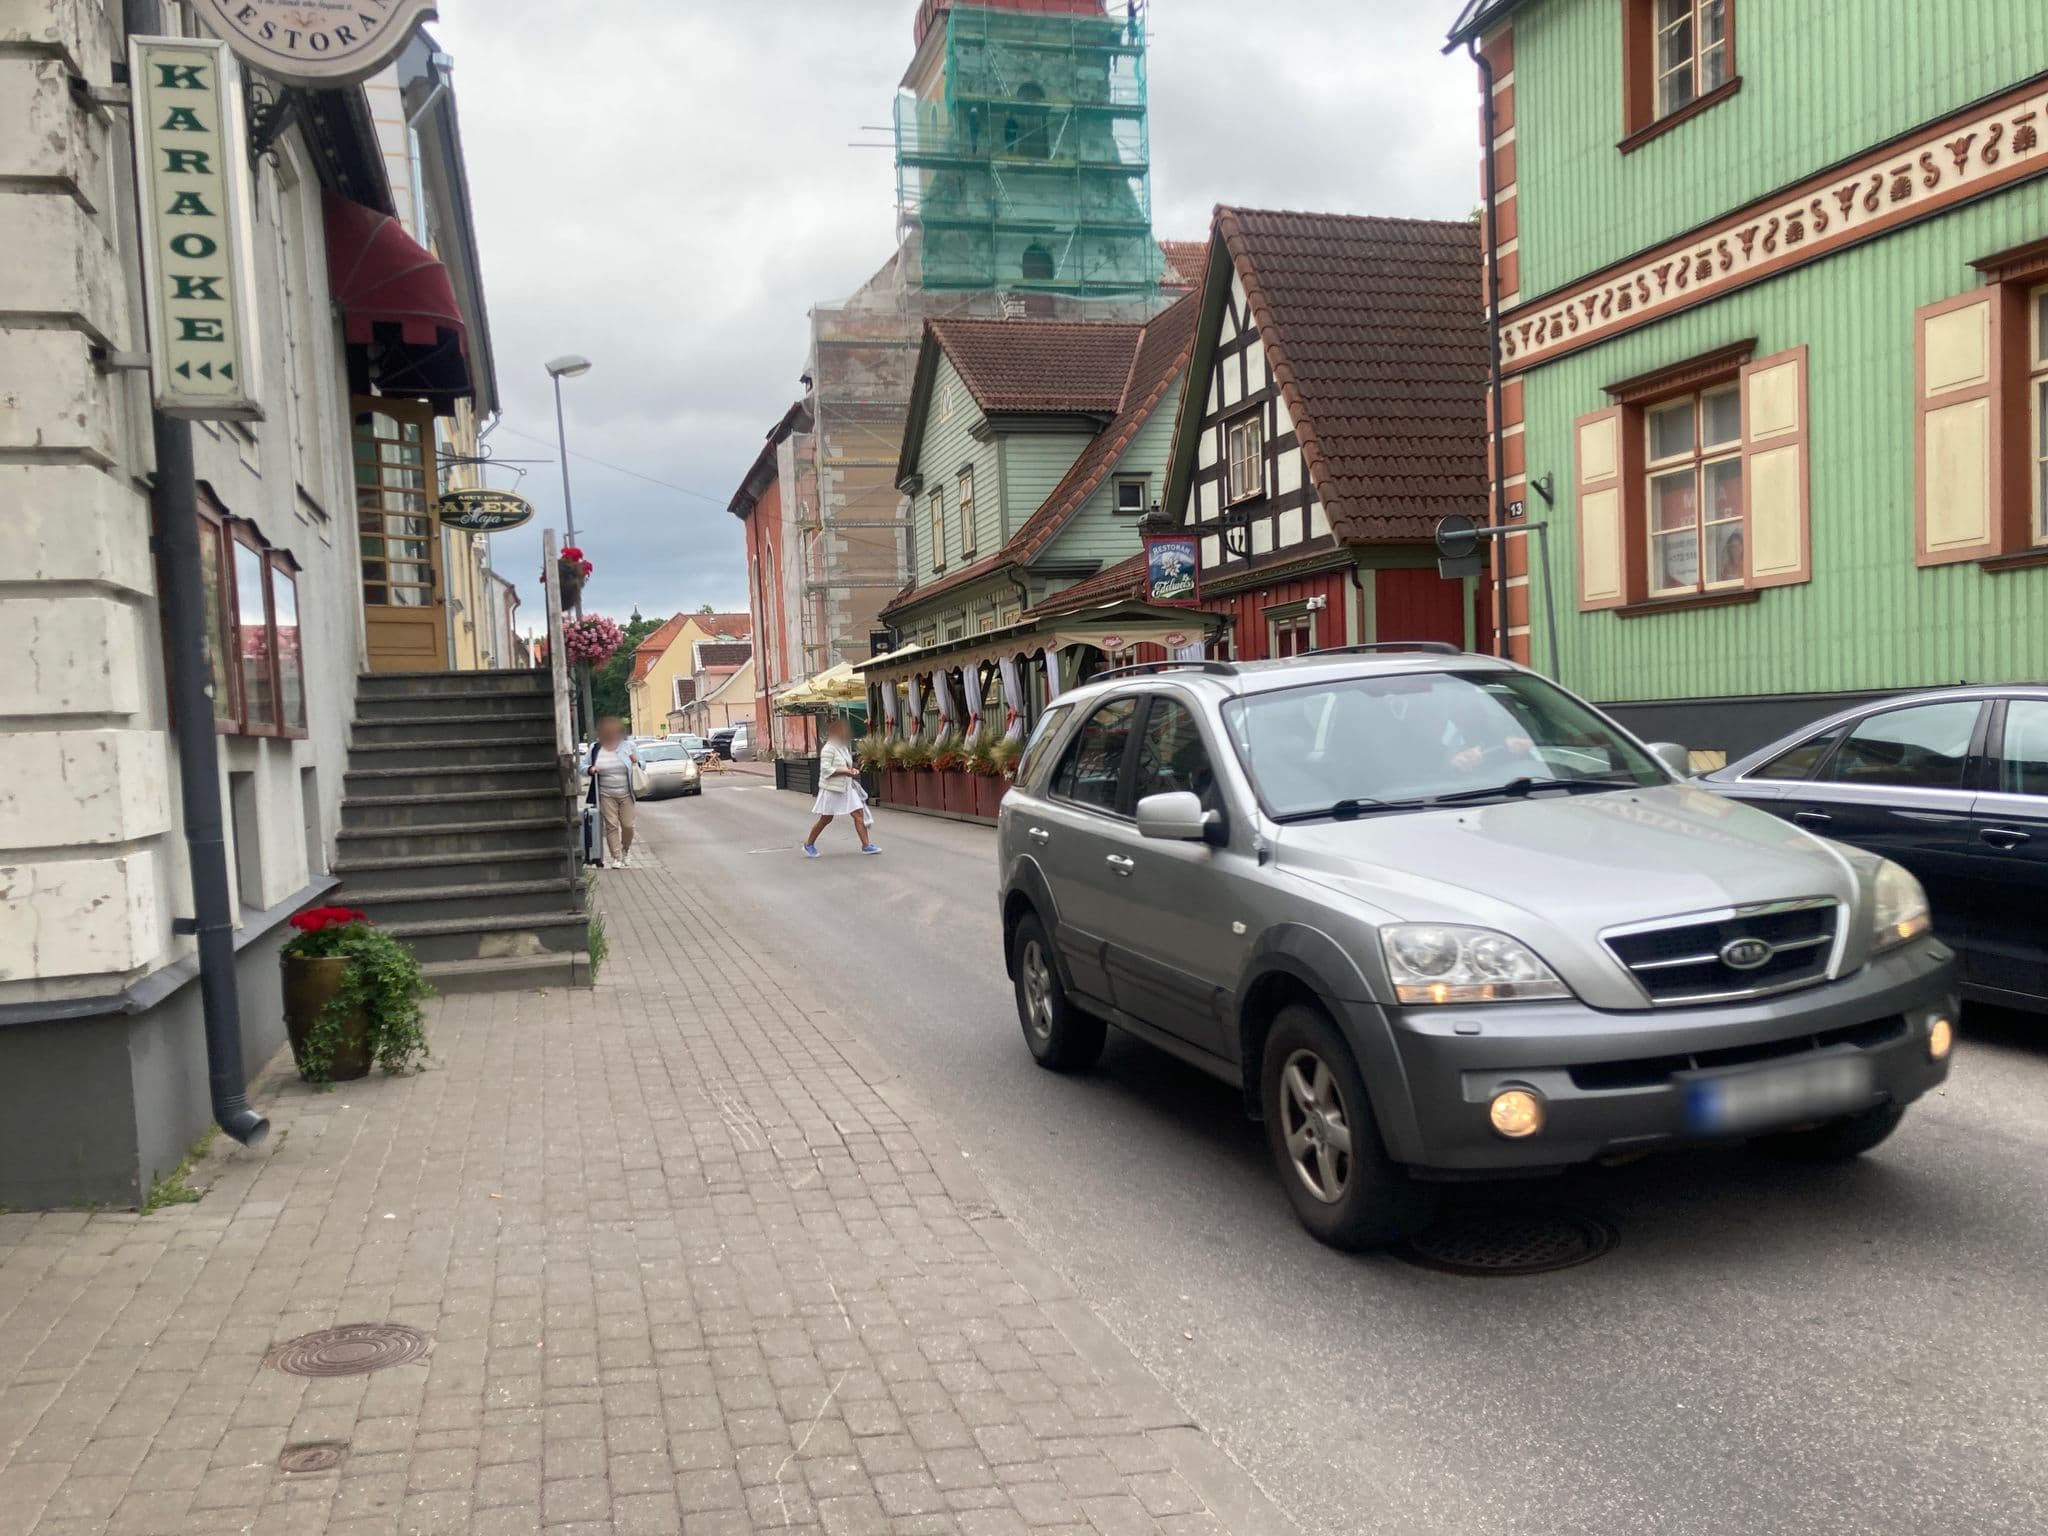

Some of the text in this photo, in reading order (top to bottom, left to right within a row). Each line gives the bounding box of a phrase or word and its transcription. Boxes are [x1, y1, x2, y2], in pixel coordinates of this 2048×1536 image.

[222, 0, 387, 51] ESTORA
[153, 63, 225, 343] KARAOKE
[441, 501, 523, 513] ALEX
[1510, 502, 1522, 516] 13
[460, 507, 502, 529] Maja
[1152, 543, 1191, 555] RESTORAN
[1729, 944, 1764, 961] KIA
